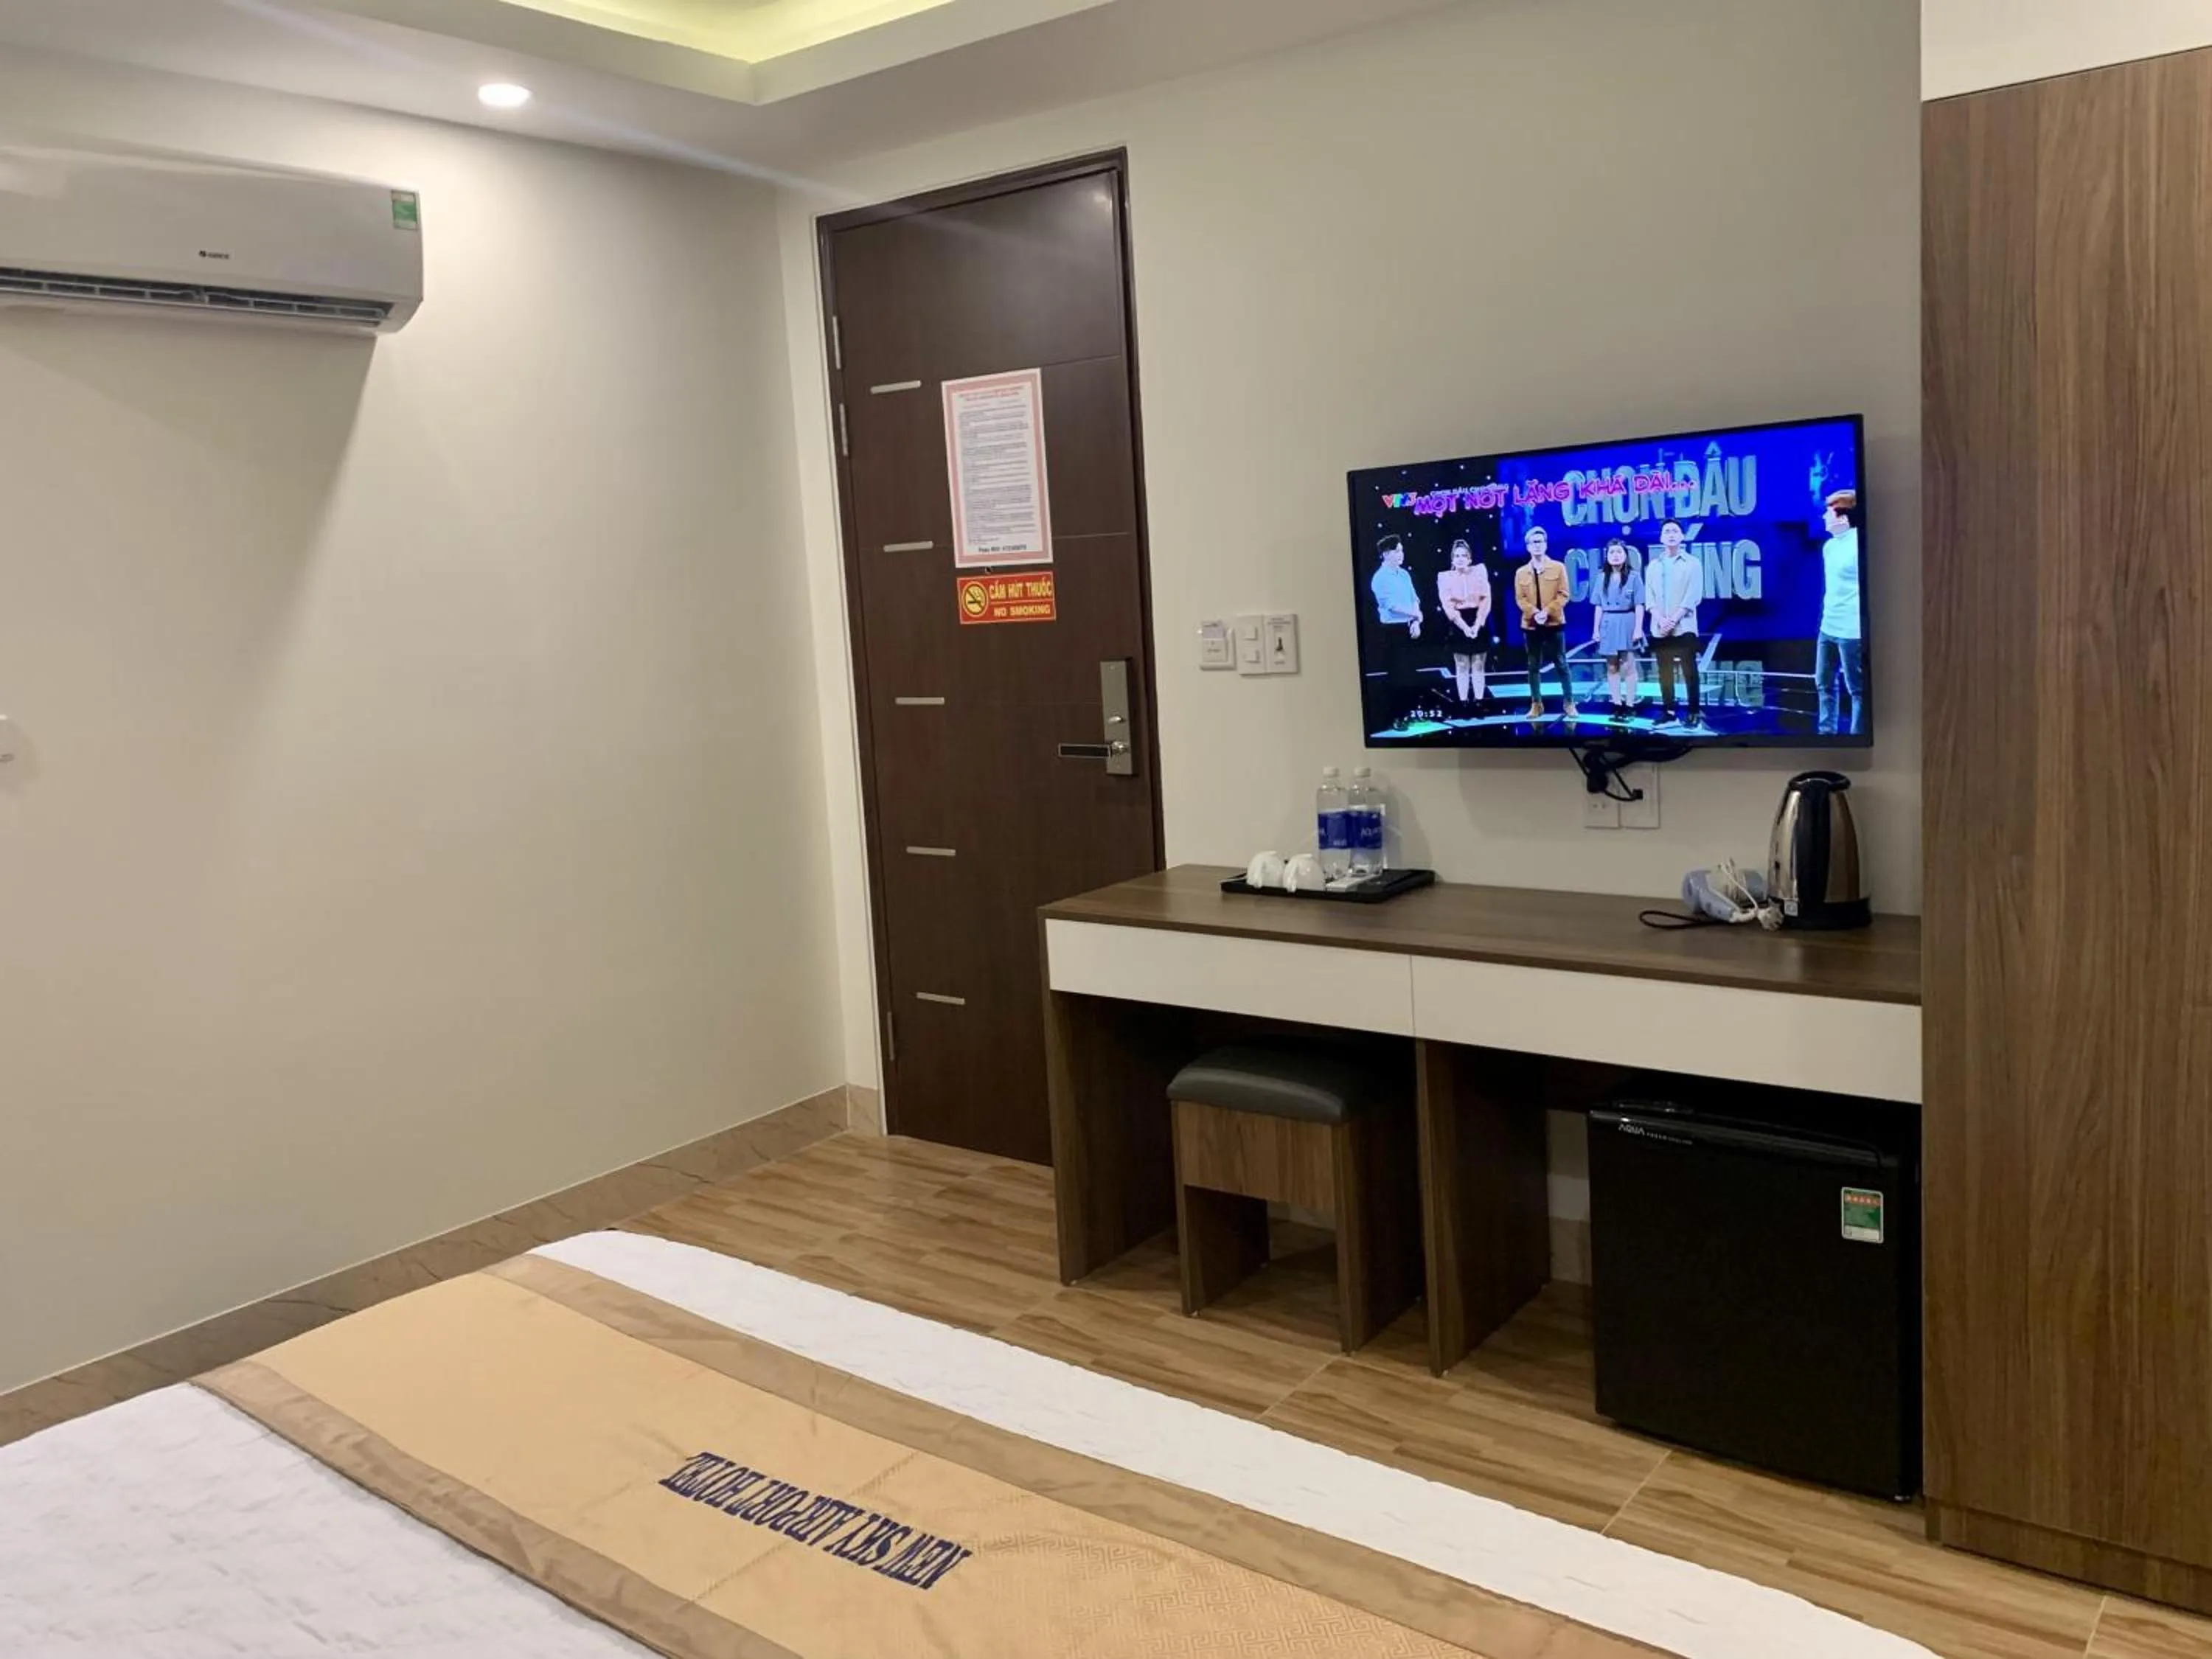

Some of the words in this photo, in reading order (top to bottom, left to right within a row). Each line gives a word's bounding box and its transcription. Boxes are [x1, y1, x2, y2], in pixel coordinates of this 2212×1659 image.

[1562, 462, 1666, 536] CHỌN
[1669, 441, 1756, 518] ĐÂU
[993, 607, 1007, 617] NO
[1009, 604, 1051, 616] SMOKING
[658, 1452, 766, 1510] HOTEL
[723, 1480, 866, 1546] AIRPORT
[824, 1514, 911, 1567] SKY
[872, 1533, 973, 1590] NEW
